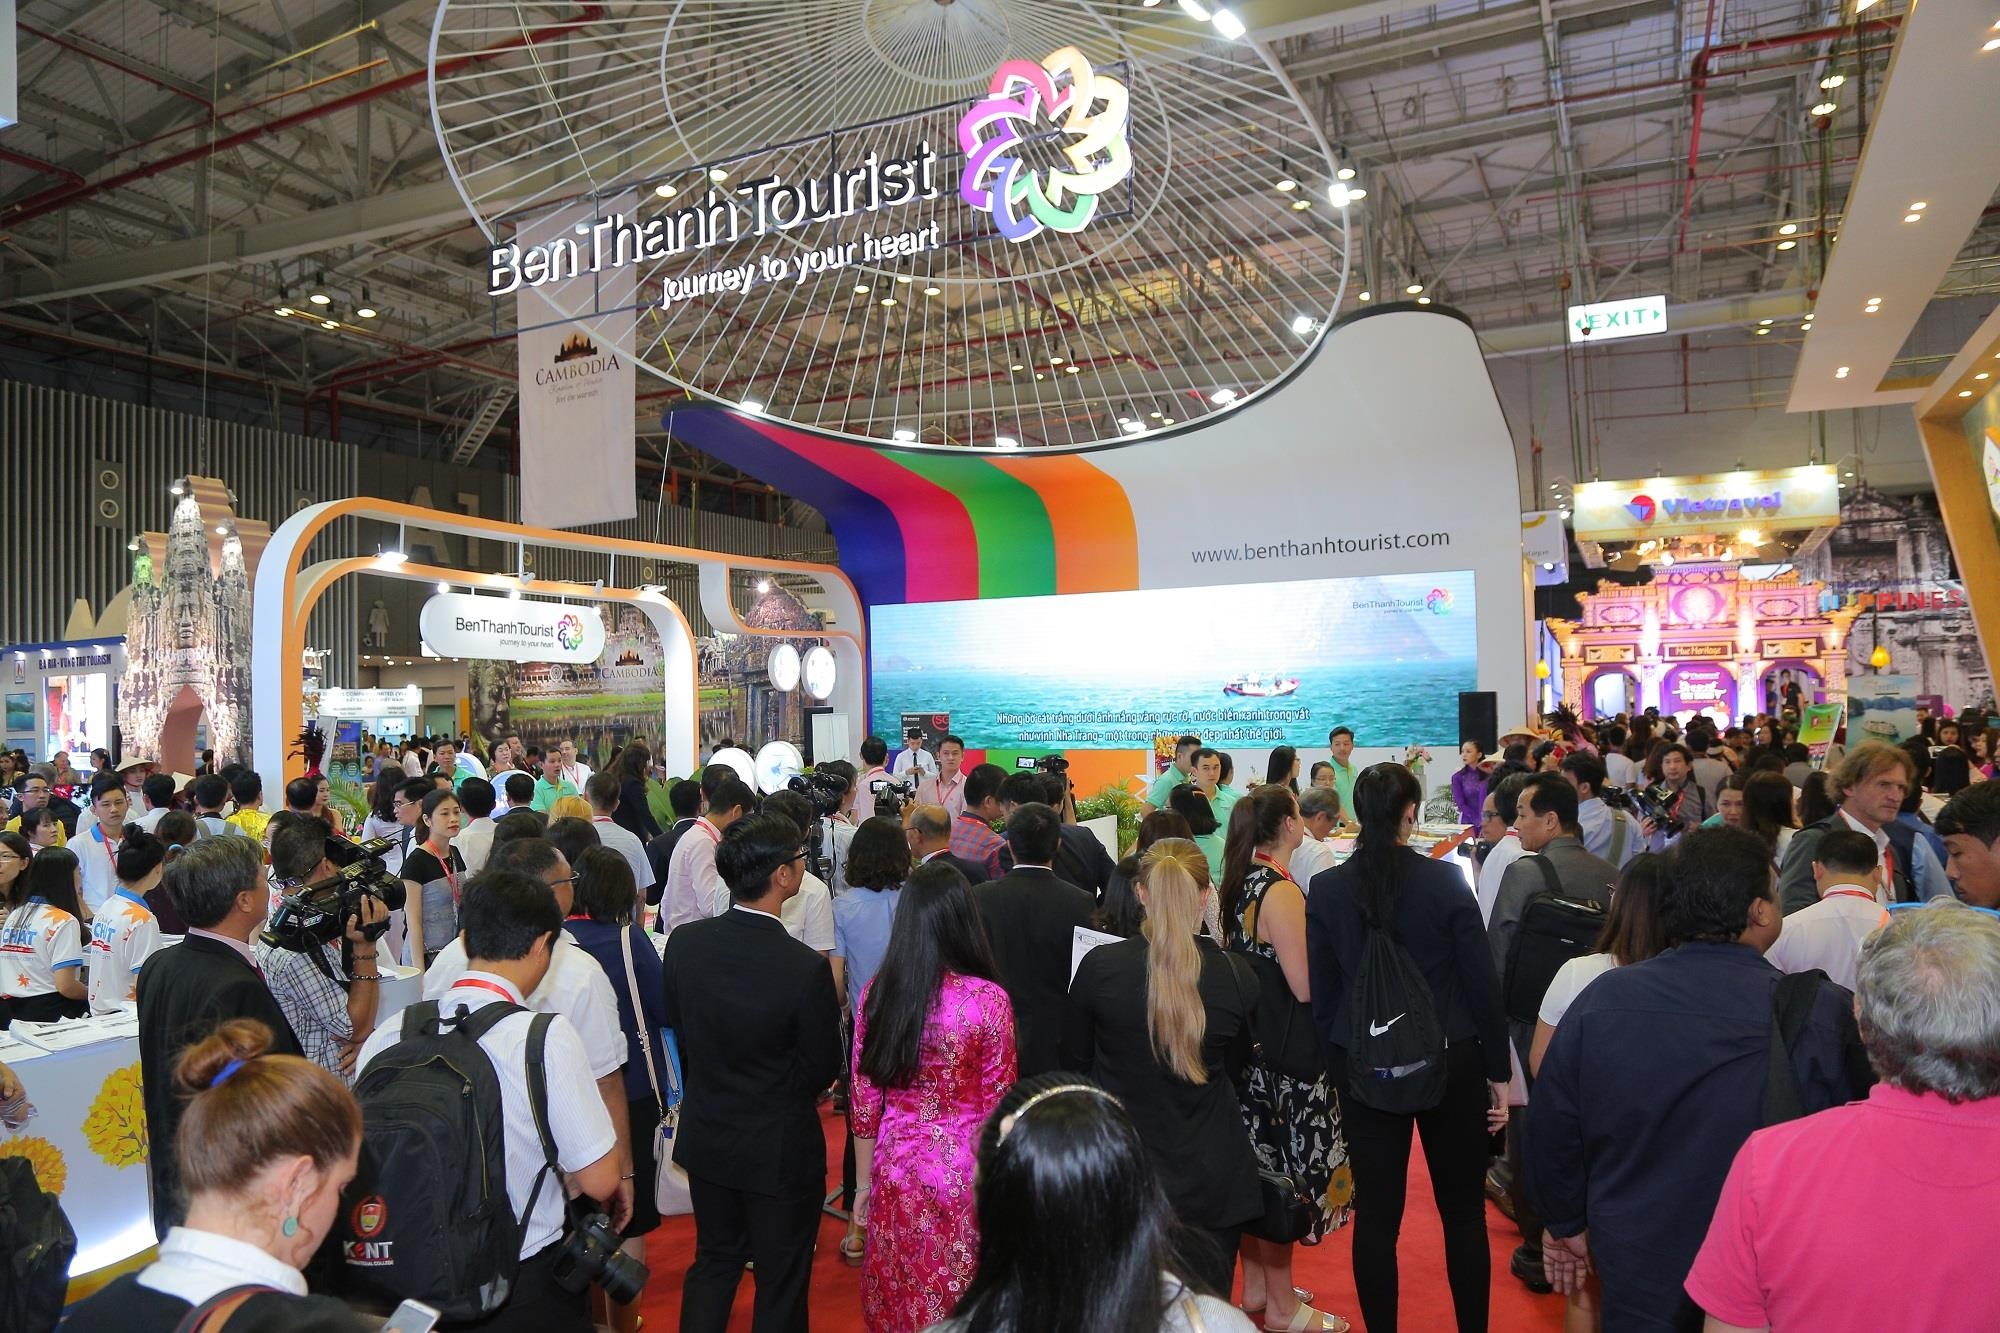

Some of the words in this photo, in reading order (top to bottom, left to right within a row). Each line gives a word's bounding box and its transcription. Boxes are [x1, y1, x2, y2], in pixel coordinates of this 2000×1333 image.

[762, 255, 786, 282] to
[795, 242, 857, 285] your
[863, 220, 939, 261] heart
[1588, 309, 1647, 330] EXIT
[535, 353, 620, 386] CAMBODIA
[1662, 491, 1781, 516] Vietravel
[1192, 531, 1450, 564] www.benthanhtourist.com
[87, 654, 112, 666] TOURISM
[601, 666, 658, 679] CAMBODIA
[997, 712, 1023, 726] Những
[1077, 711, 1095, 723] dưới
[1097, 711, 1113, 723] ánh
[1139, 711, 1161, 725] vàng
[1194, 710, 1216, 721] nước
[1241, 708, 1264, 720] xanh
[1265, 709, 1292, 723] trong
[1056, 729, 1072, 741] Nha
[1105, 730, 1123, 743] một
[1124, 730, 1149, 744] trong
[1203, 728, 1220, 743] đẹp
